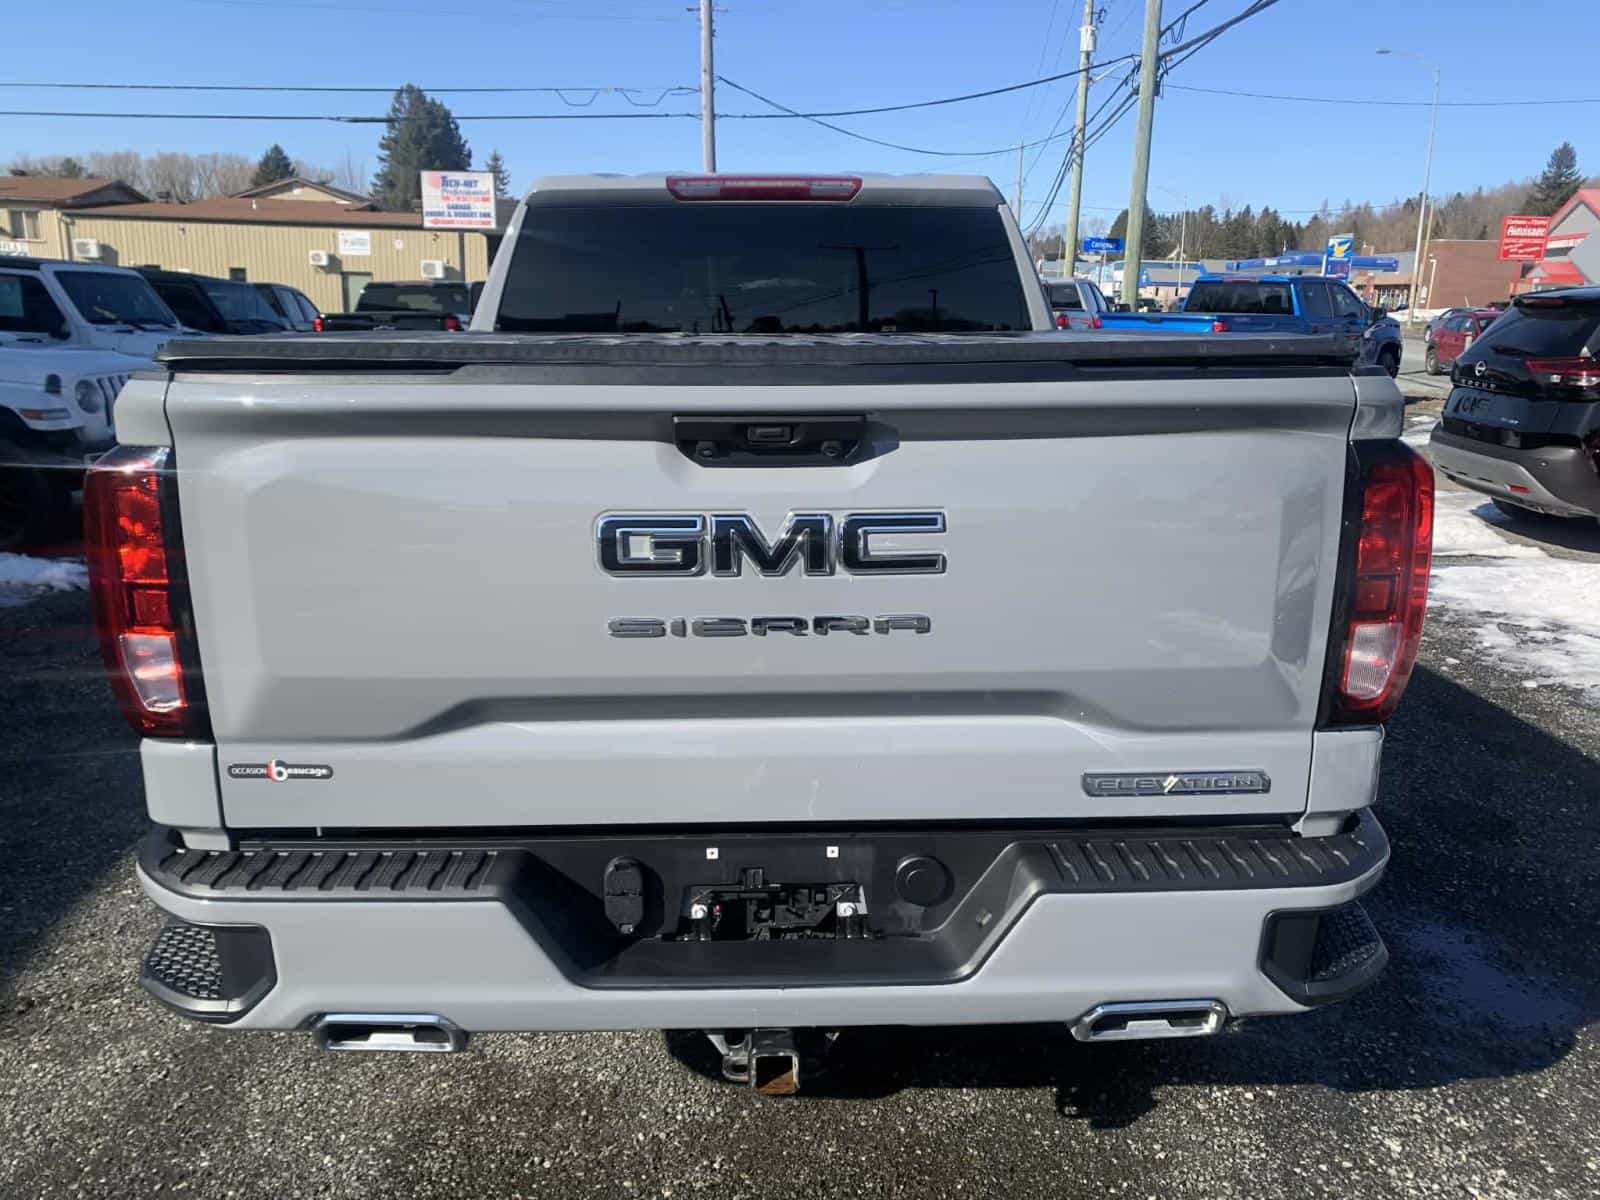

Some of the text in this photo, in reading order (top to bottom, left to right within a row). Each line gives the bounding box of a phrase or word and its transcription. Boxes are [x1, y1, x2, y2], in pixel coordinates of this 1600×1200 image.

[597, 511, 948, 577] GMC
[607, 614, 931, 637] SIERRA
[1095, 775, 1257, 793] ELEVATION
